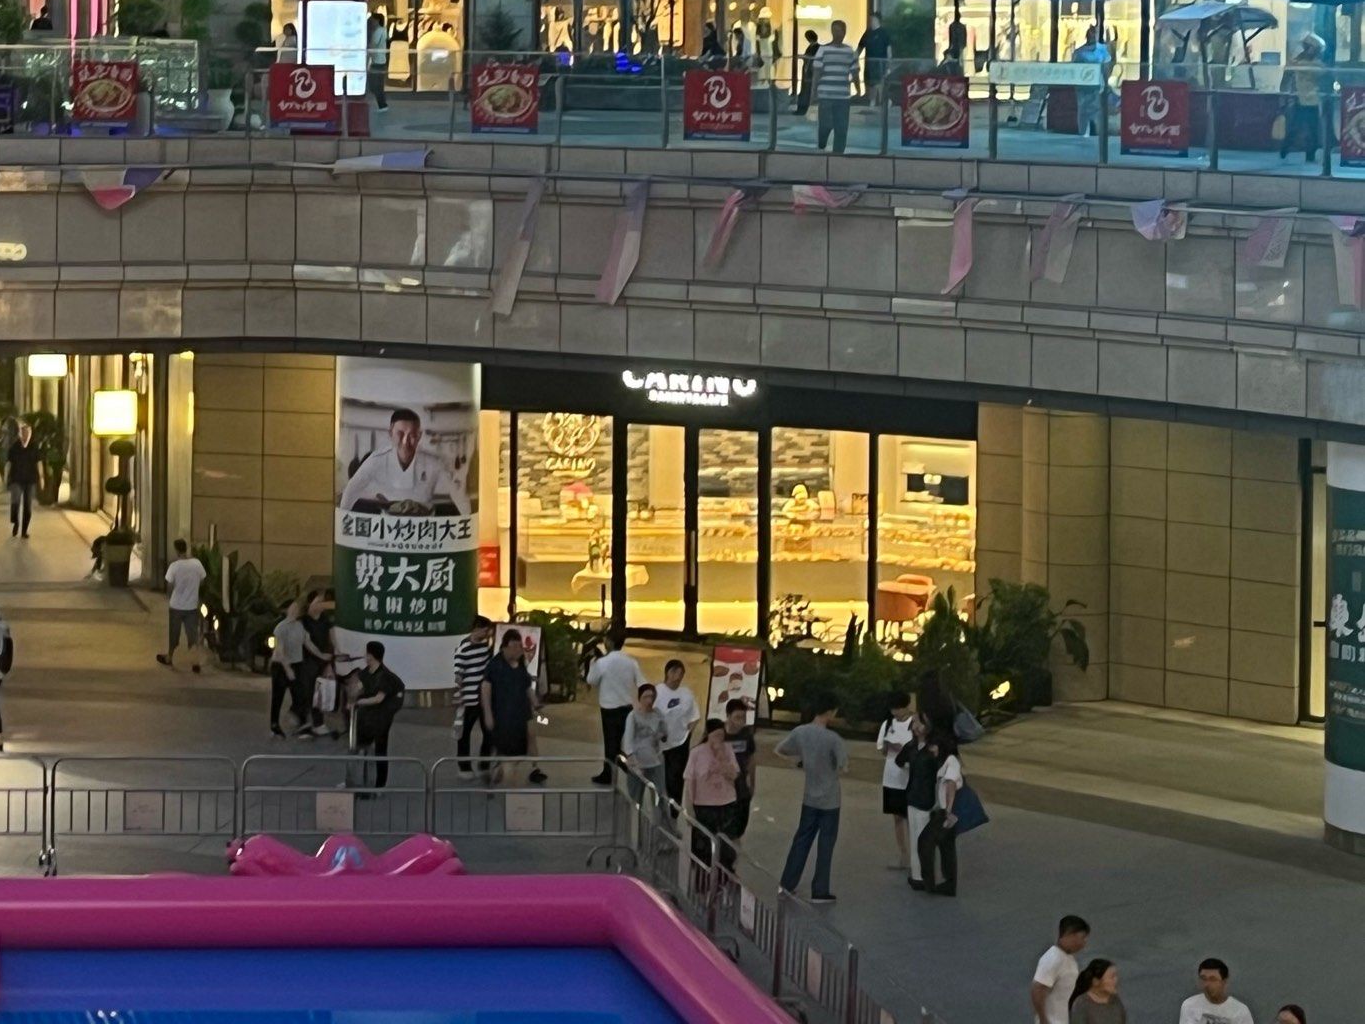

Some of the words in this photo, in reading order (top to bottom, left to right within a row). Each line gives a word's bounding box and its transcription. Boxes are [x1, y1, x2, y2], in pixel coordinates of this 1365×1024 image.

[342, 515, 472, 542] 全国小炒肉大王
[355, 553, 455, 593] 费大厨
